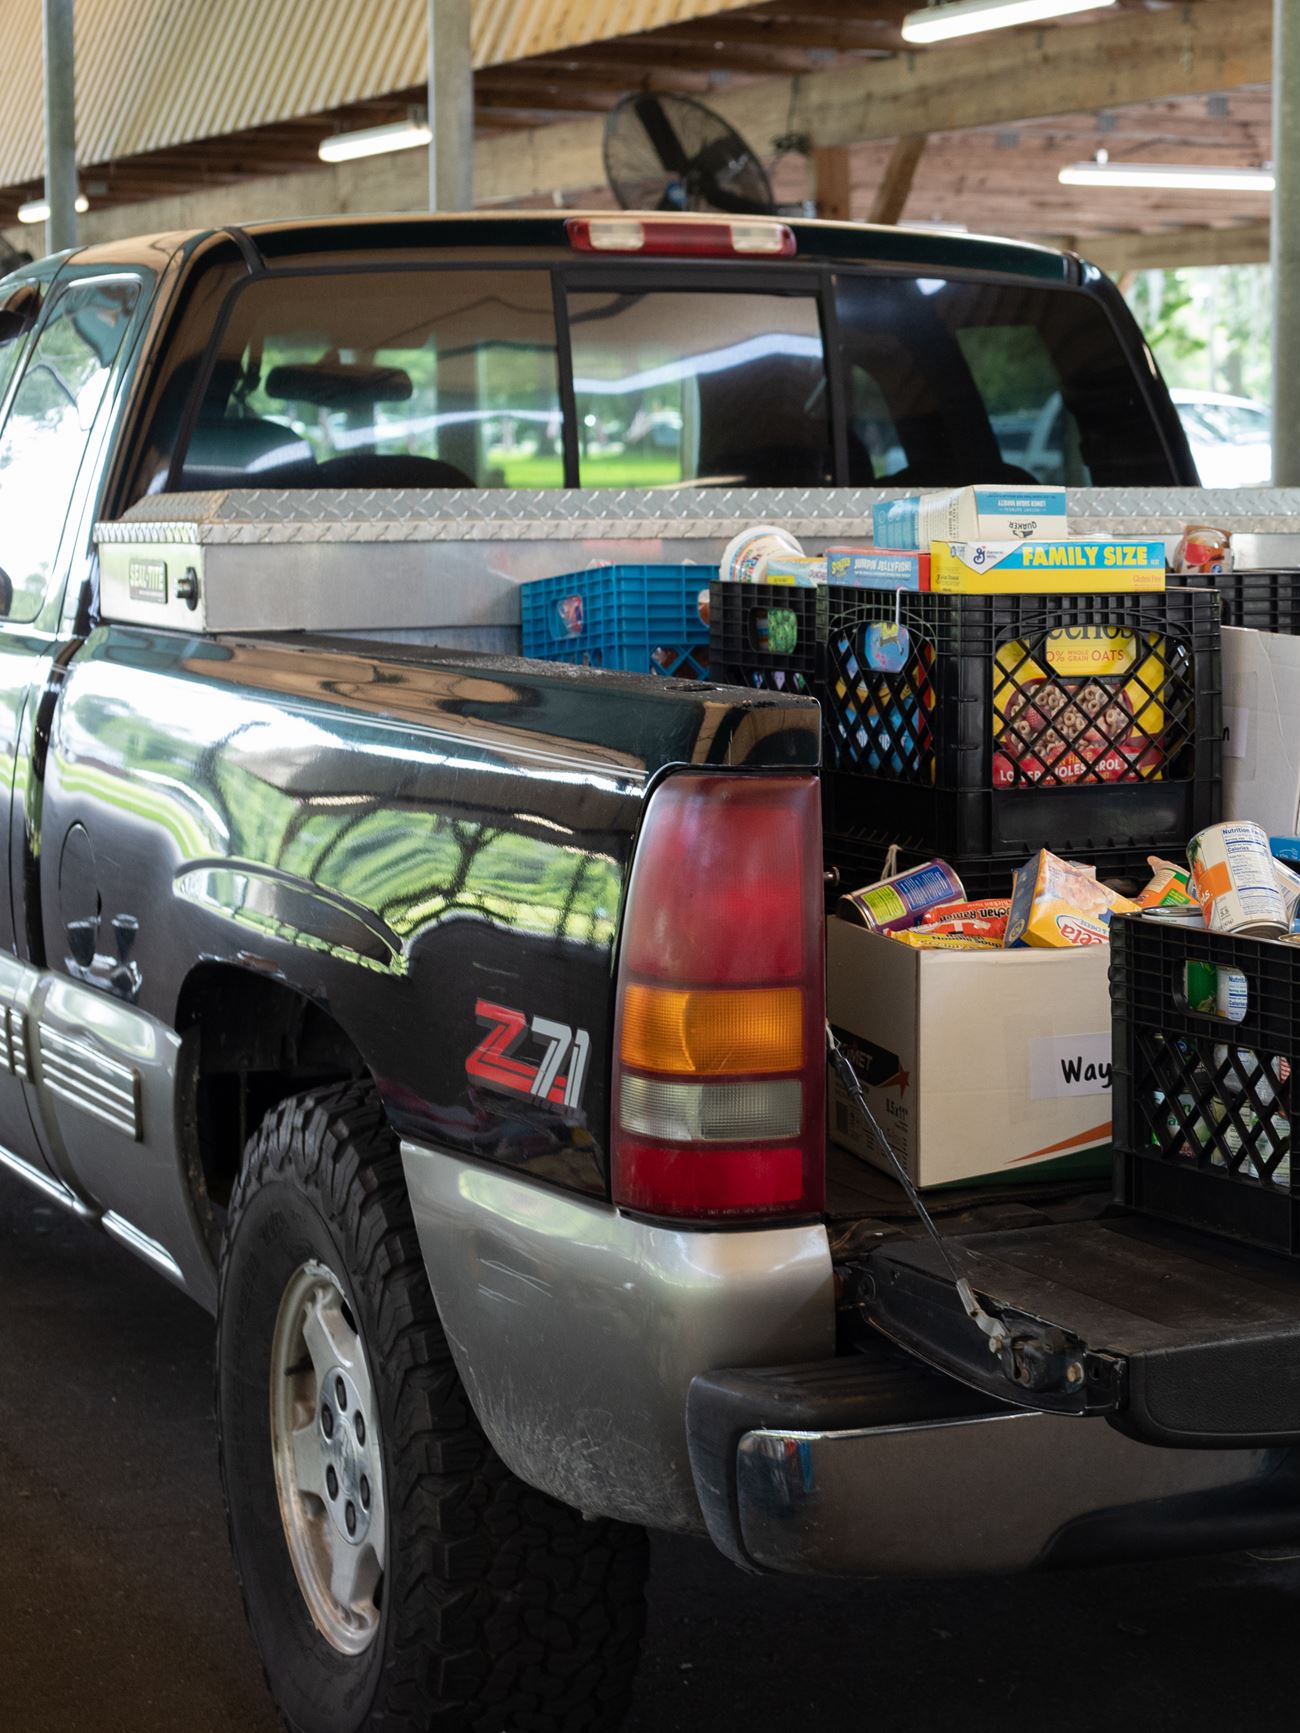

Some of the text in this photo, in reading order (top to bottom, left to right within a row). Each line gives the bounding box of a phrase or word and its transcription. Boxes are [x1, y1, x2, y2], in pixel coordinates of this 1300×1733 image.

[1009, 521, 1038, 530] QUAKER
[1022, 546, 1148, 566] FAMILY SIZE
[1046, 650, 1064, 662] 0%
[1091, 650, 1125, 662] OATS
[939, 909, 977, 923] Ramen
[465, 998, 590, 1109] Z71
[1061, 1056, 1113, 1089] Way
